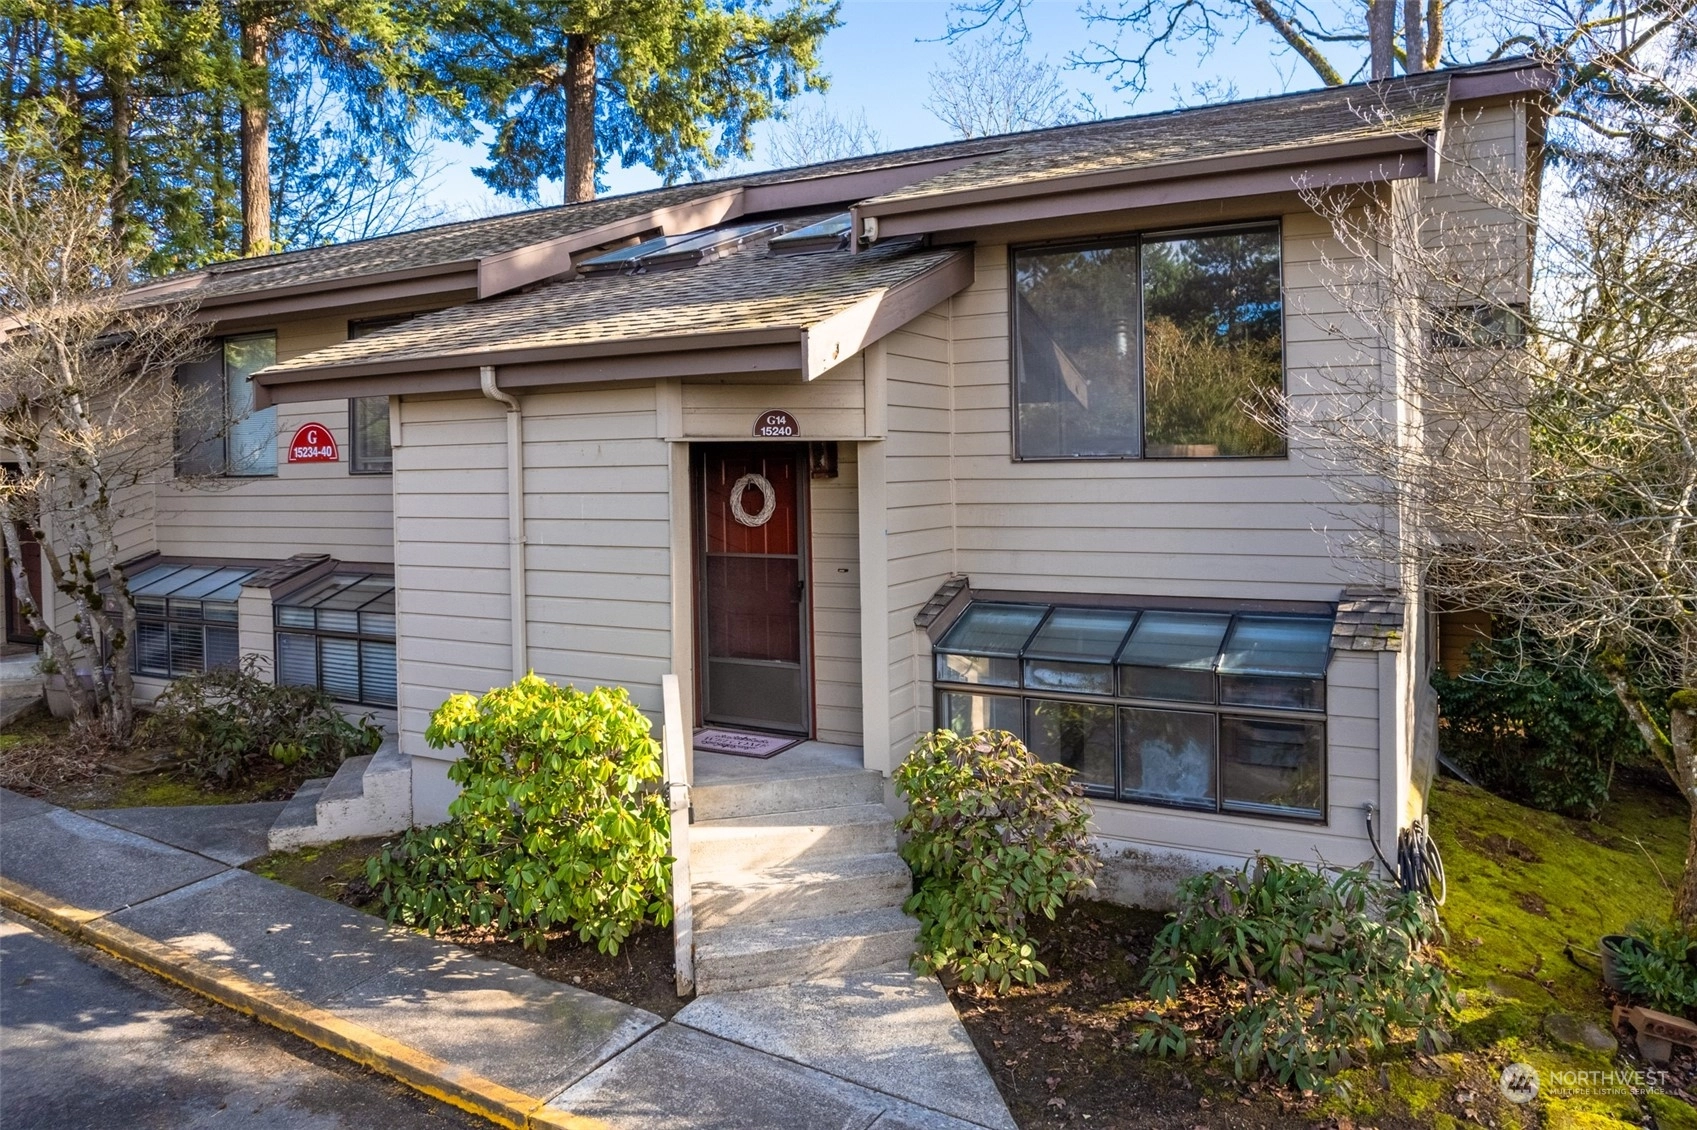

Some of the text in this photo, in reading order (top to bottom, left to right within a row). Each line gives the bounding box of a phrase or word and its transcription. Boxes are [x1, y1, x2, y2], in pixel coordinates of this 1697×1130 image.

[767, 415, 787, 425] G14
[760, 426, 792, 436] 15240
[307, 430, 317, 444] G
[294, 446, 332, 458] 15234-40
